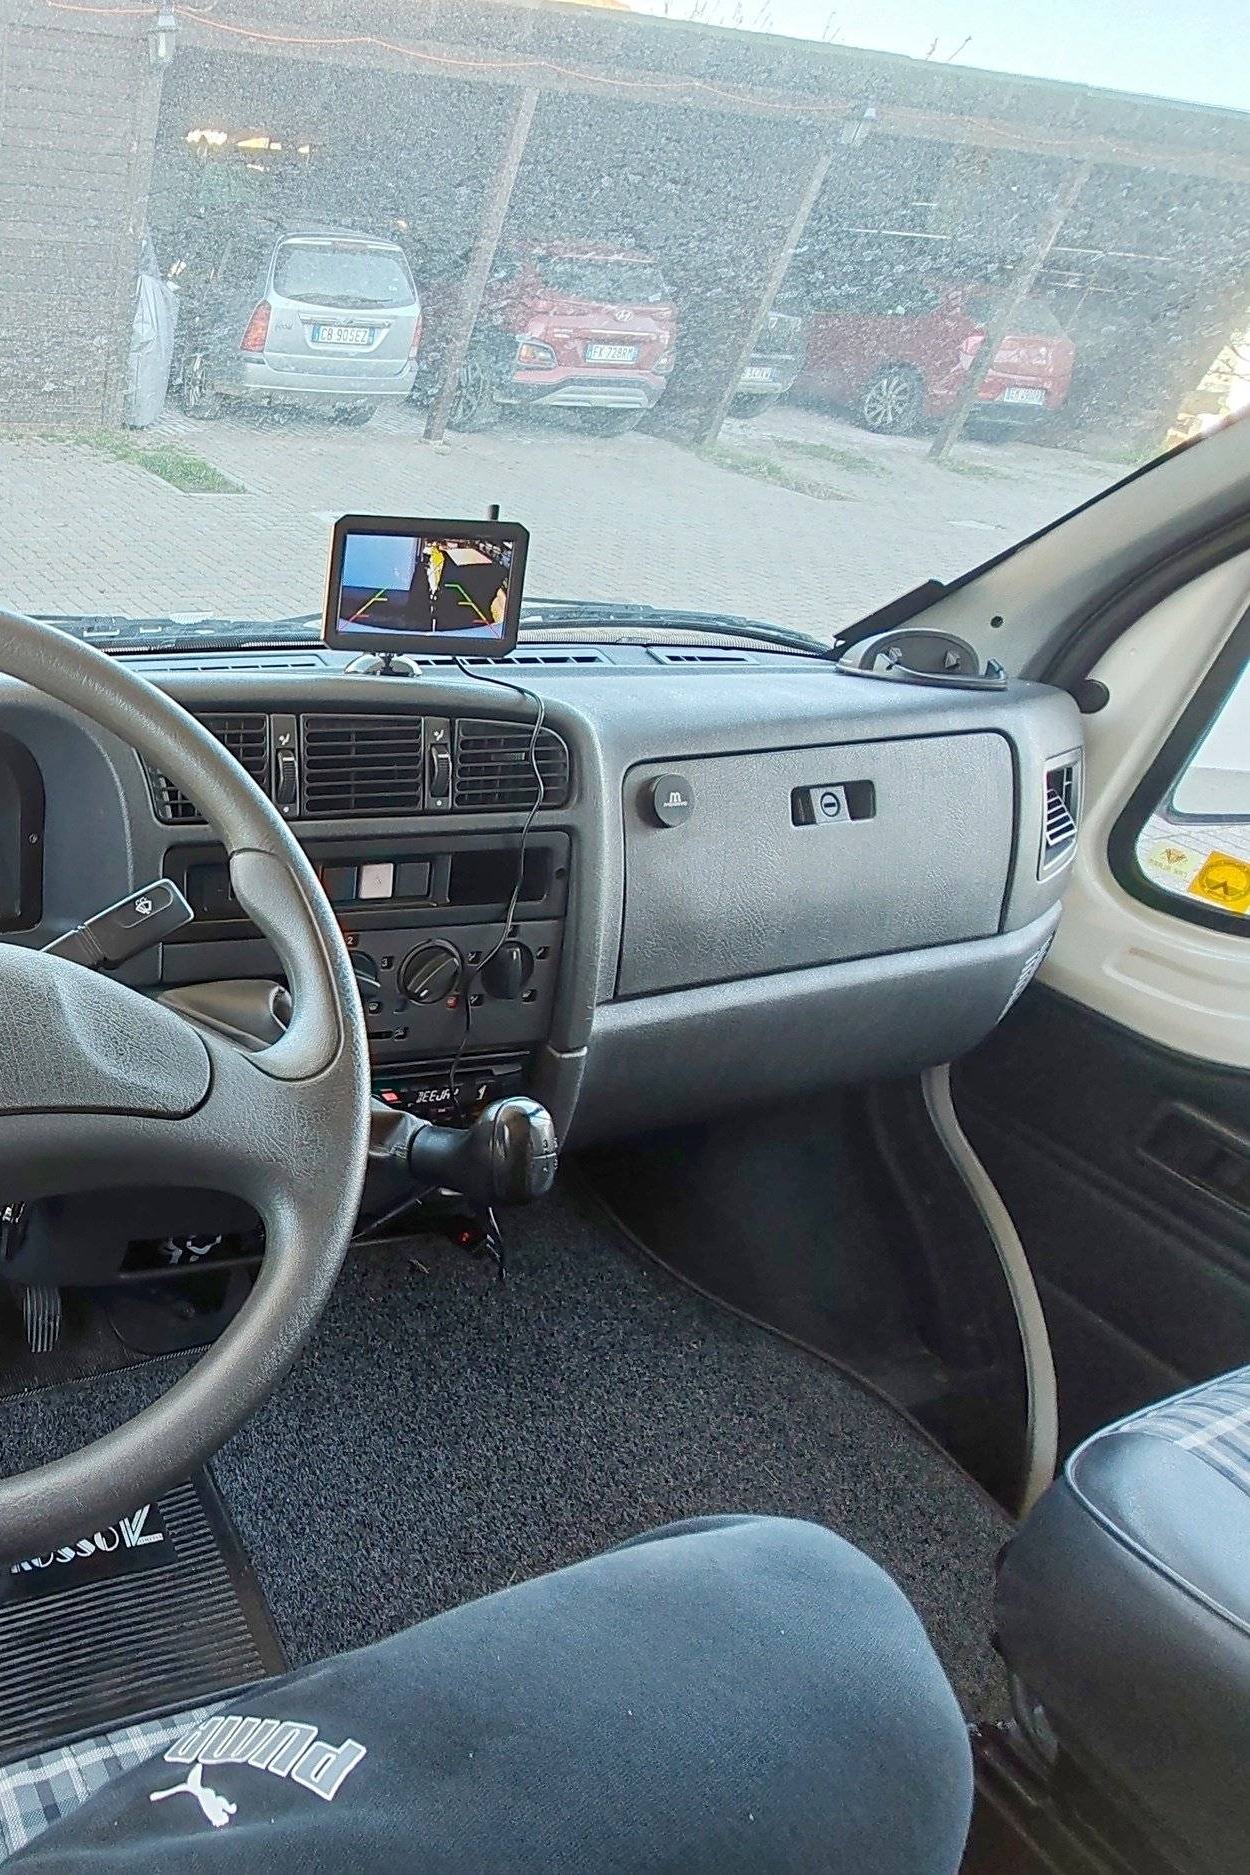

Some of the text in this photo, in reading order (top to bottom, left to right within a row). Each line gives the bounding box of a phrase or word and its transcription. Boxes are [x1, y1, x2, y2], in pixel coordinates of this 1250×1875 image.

[346, 936, 354, 945] 2
[381, 958, 388, 967] 3
[164, 1715, 367, 1801] PUMA
